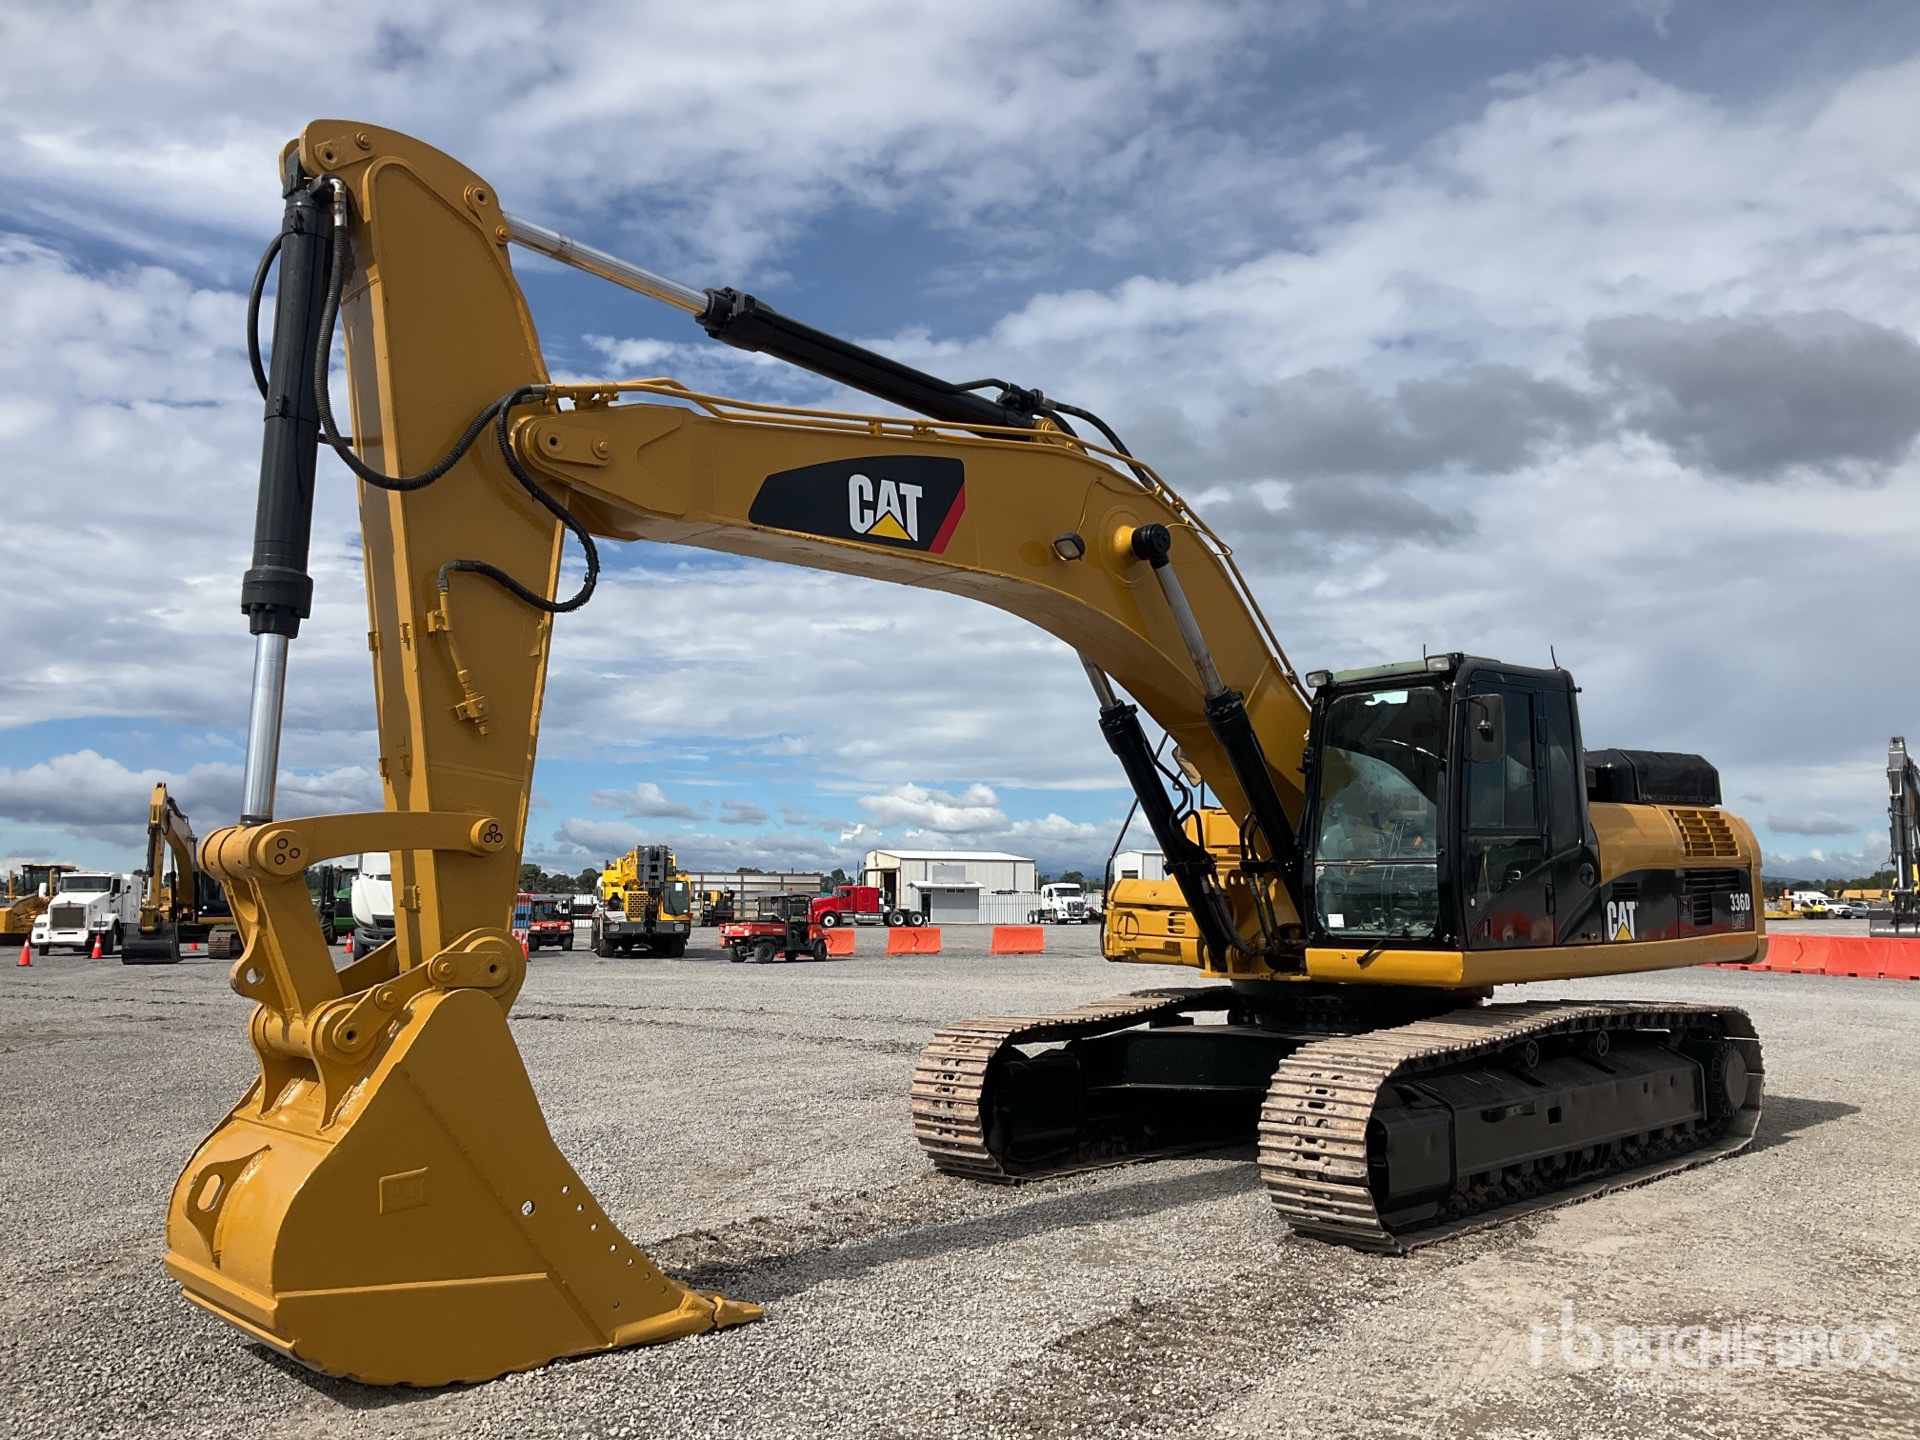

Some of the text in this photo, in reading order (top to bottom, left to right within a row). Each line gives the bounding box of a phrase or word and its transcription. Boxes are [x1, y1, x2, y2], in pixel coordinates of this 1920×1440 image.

[848, 474, 923, 542] CAT
[1606, 901, 1636, 941] CAT
[1730, 893, 1751, 911] 336D
